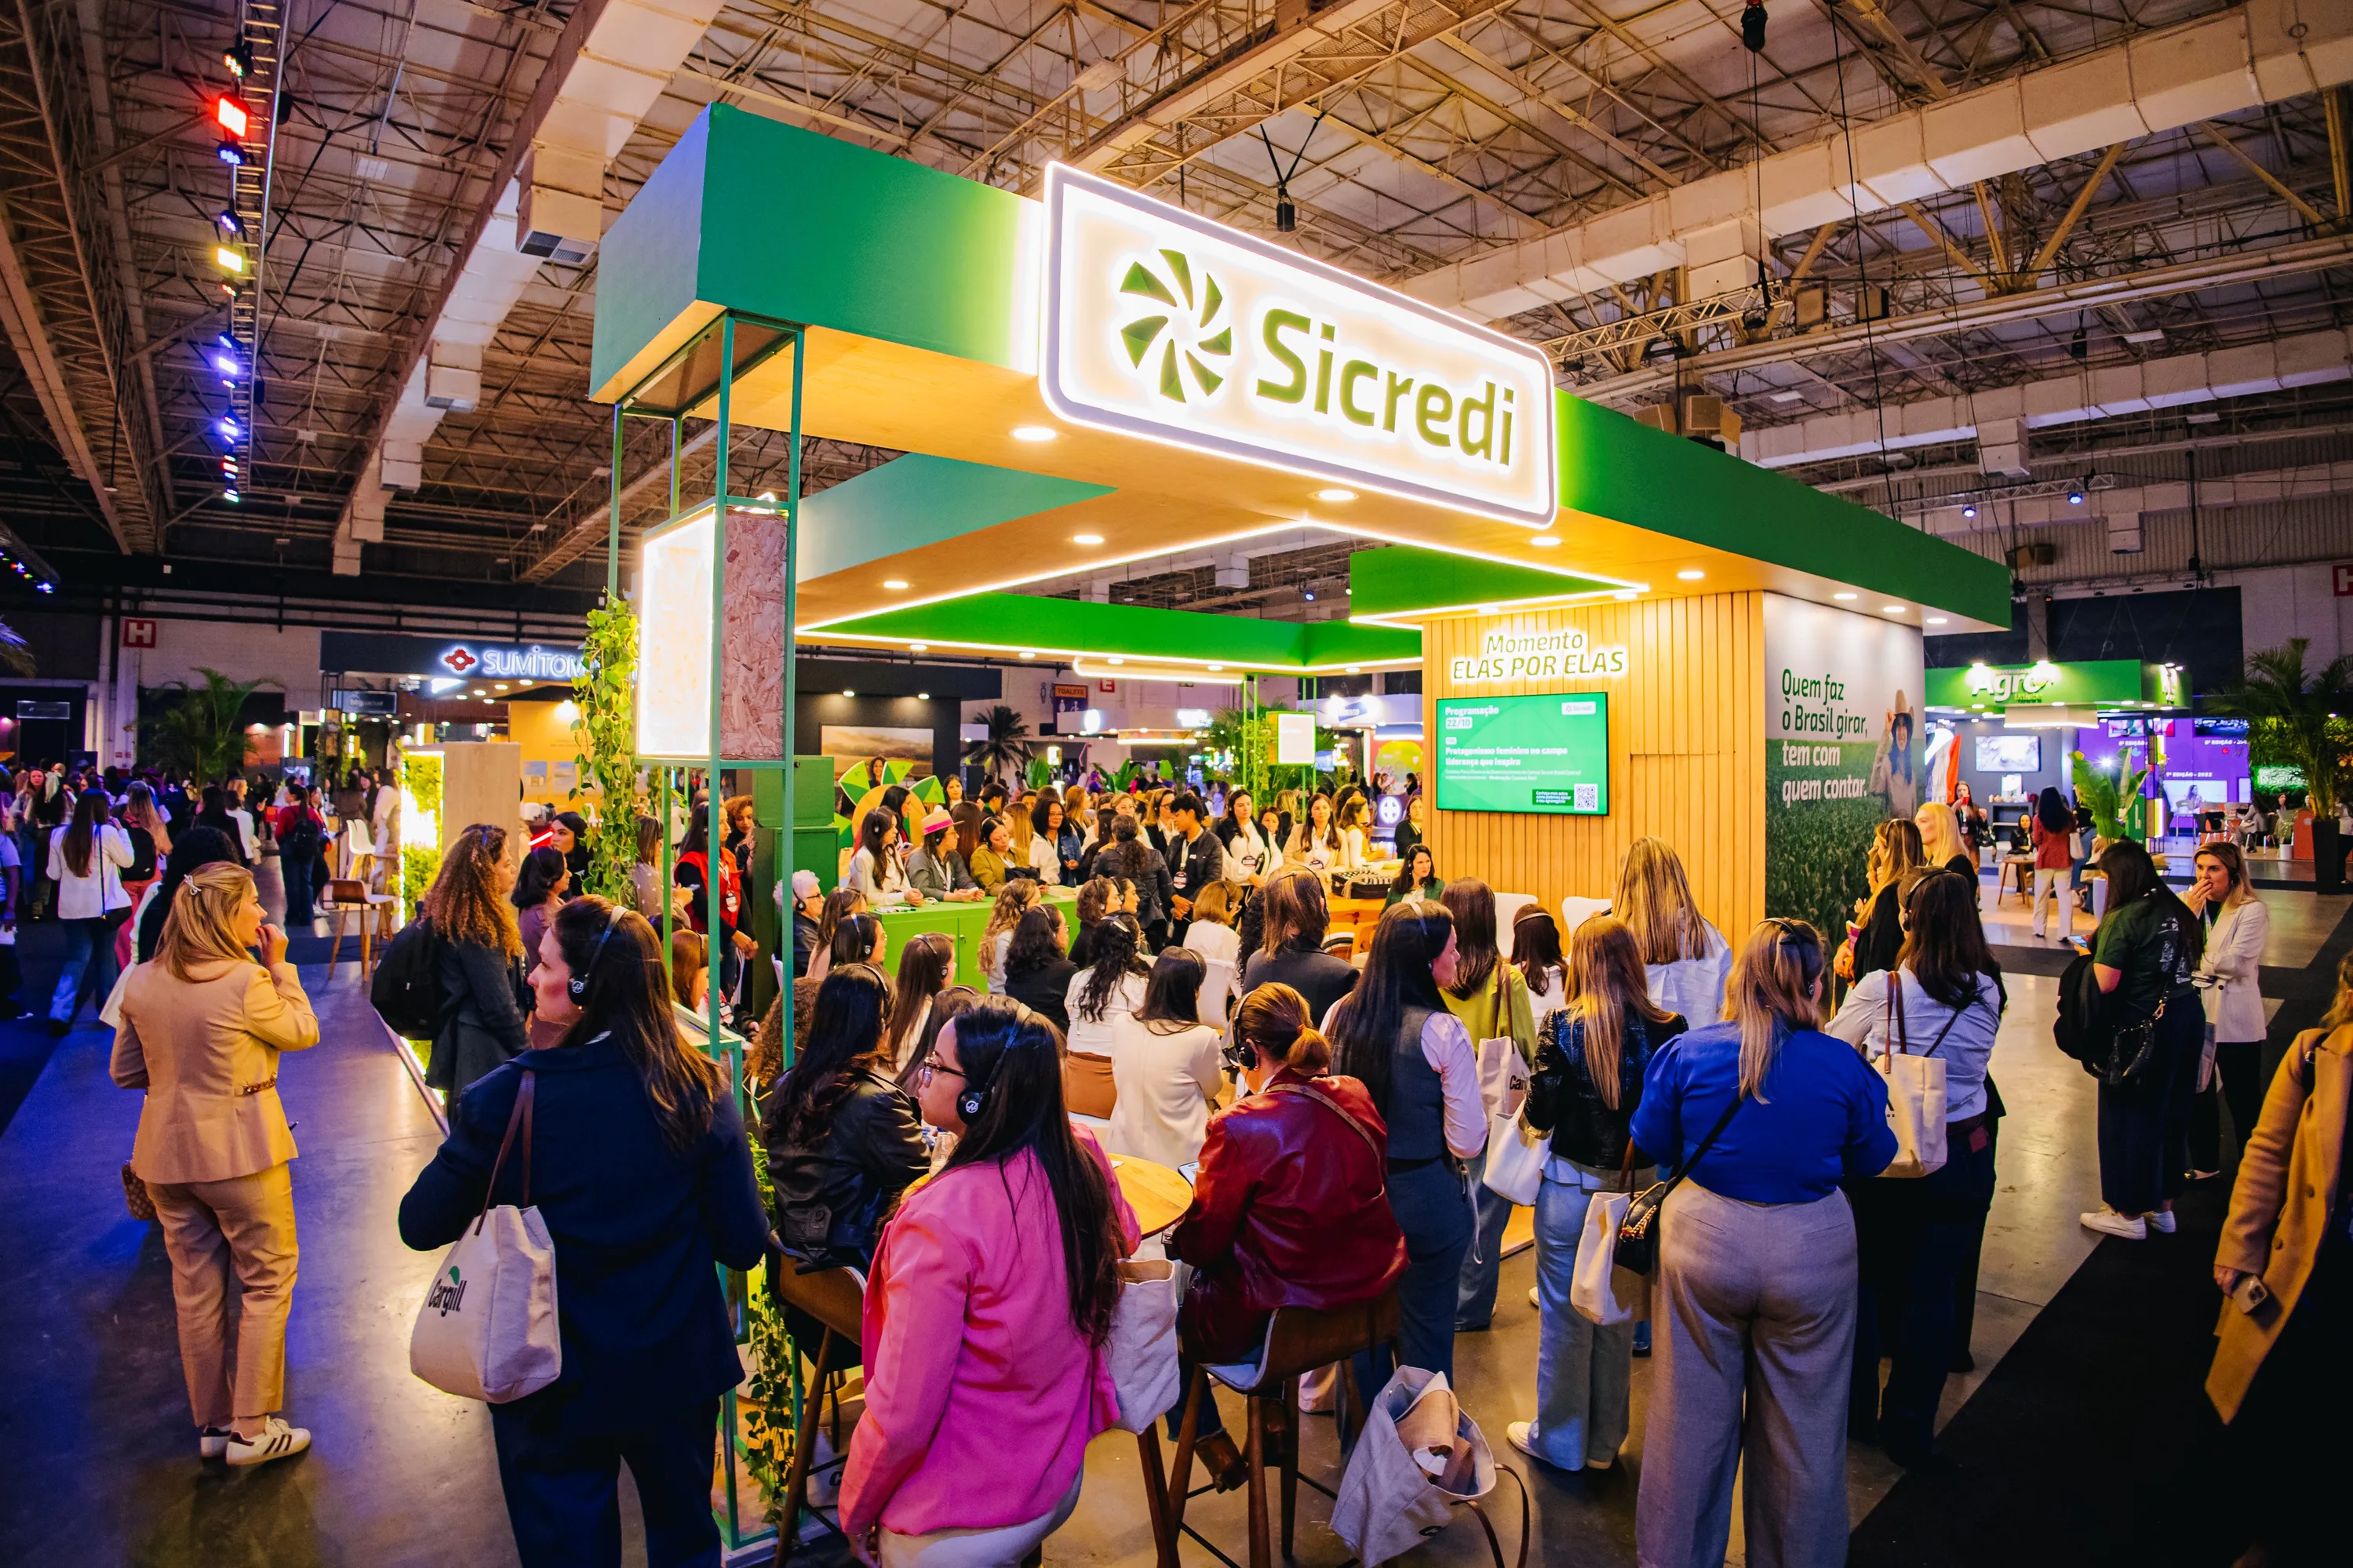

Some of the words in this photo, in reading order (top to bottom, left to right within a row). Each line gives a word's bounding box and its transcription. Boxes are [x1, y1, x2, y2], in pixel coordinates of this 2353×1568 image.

[1256, 308, 1514, 467] Sicredi
[129, 622, 152, 644] H
[1486, 631, 1583, 654] Momento
[483, 646, 587, 678] SUMITOM
[1453, 658, 1505, 679] ELAS
[1511, 655, 1557, 677] POR
[1564, 651, 1624, 675] ELAS
[1782, 668, 1821, 704] Quem
[1823, 674, 1844, 706] faz
[1444, 705, 1499, 717] Programação
[1447, 719, 1471, 728] 22/10
[1782, 711, 1791, 730] o
[1794, 704, 1834, 733] Brasil
[1836, 708, 1868, 740] girar,
[1445, 747, 1495, 756] Protagonismo
[1541, 748, 1568, 756] campo
[1480, 759, 1493, 767] que
[1494, 758, 1521, 767] inspira
[1782, 740, 1810, 766] tem
[1812, 745, 1841, 766] com
[1782, 779, 1822, 809] quem
[1823, 774, 1867, 800] contar.
[428, 1278, 468, 1318] Cargill
